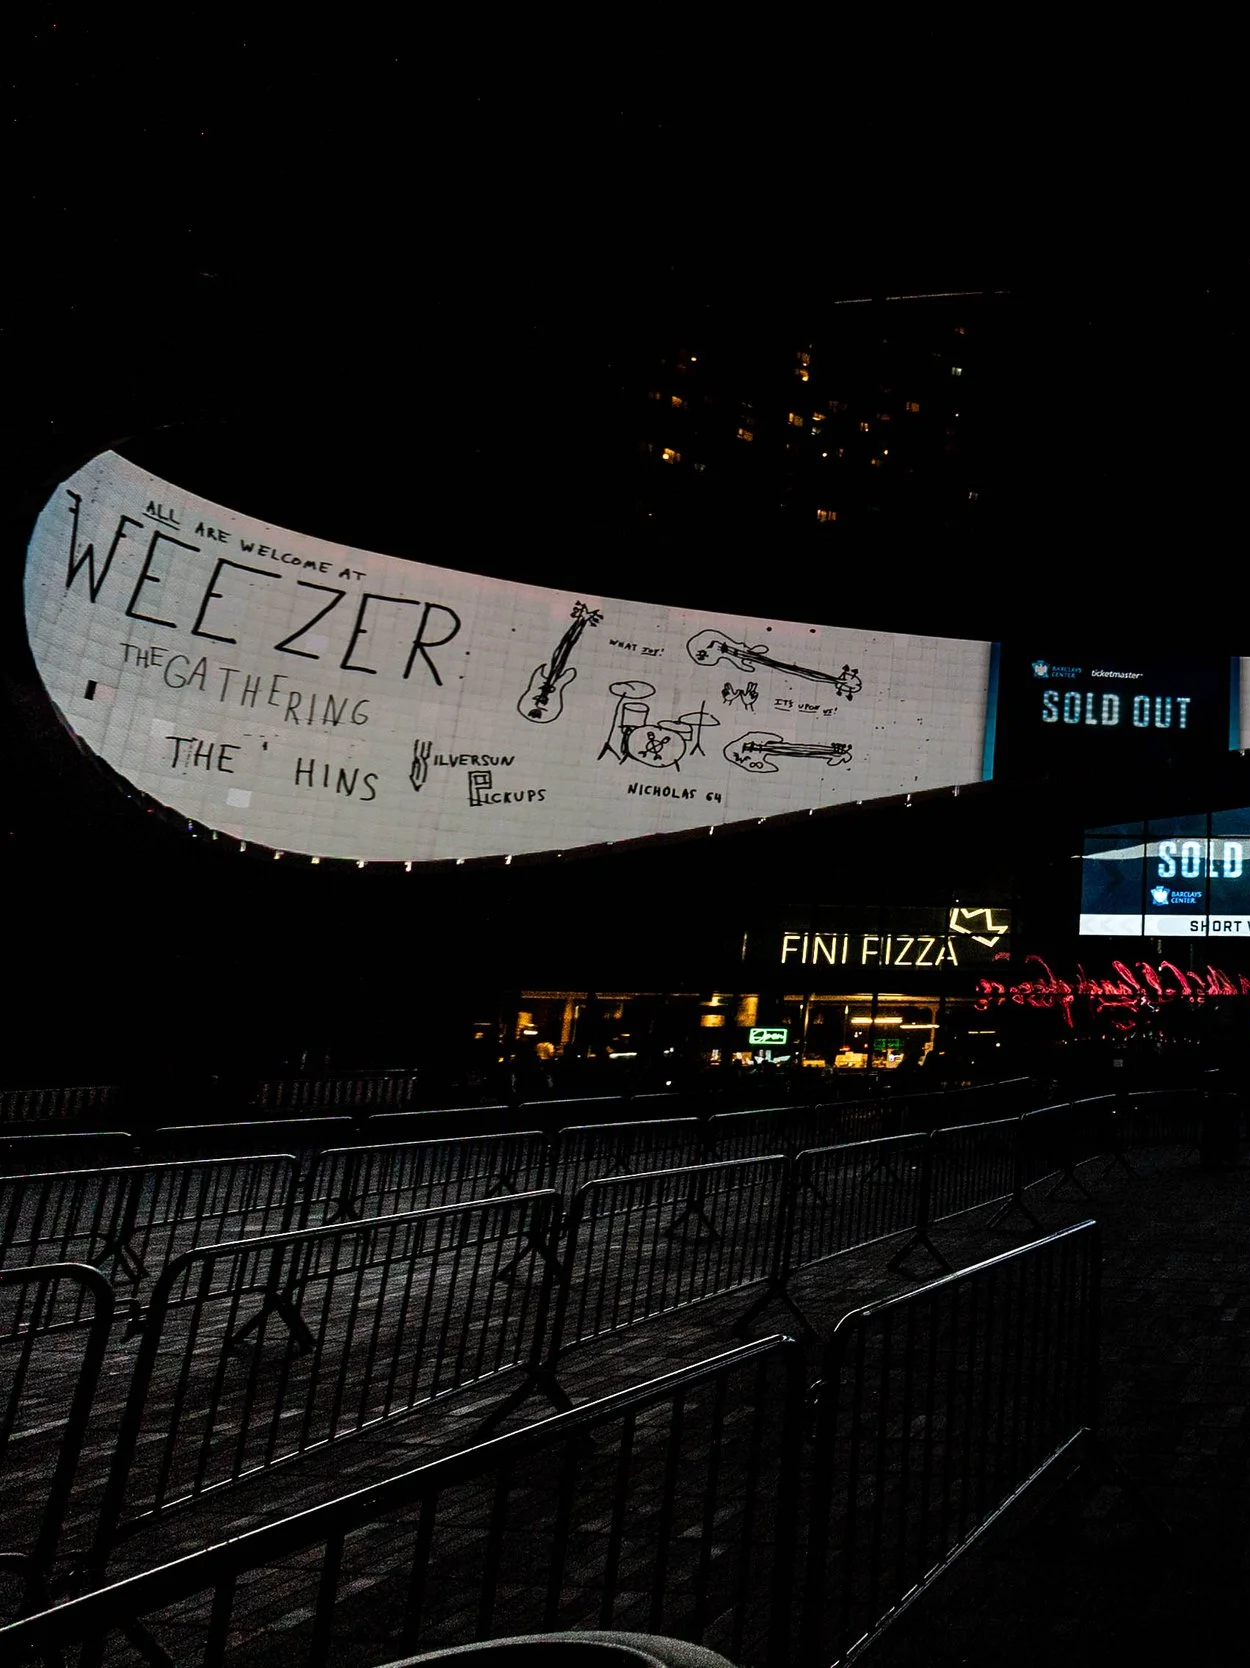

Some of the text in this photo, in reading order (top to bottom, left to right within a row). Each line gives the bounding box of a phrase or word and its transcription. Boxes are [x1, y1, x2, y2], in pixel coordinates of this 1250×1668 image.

[146, 500, 367, 582] ALL ARE WELCOME AT
[609, 639, 637, 651] WHAT
[119, 642, 370, 726] THE GATHERING
[1052, 666, 1082, 674] BARCLAYS
[1091, 669, 1141, 679] ticketmaster
[1042, 690, 1191, 729] SOLD OUT
[166, 736, 241, 774] THE
[628, 782, 697, 800] NICHOLAS
[1157, 841, 1243, 879] SOLD
[1190, 920, 1242, 933] SHORT
[781, 934, 849, 965] FINI
